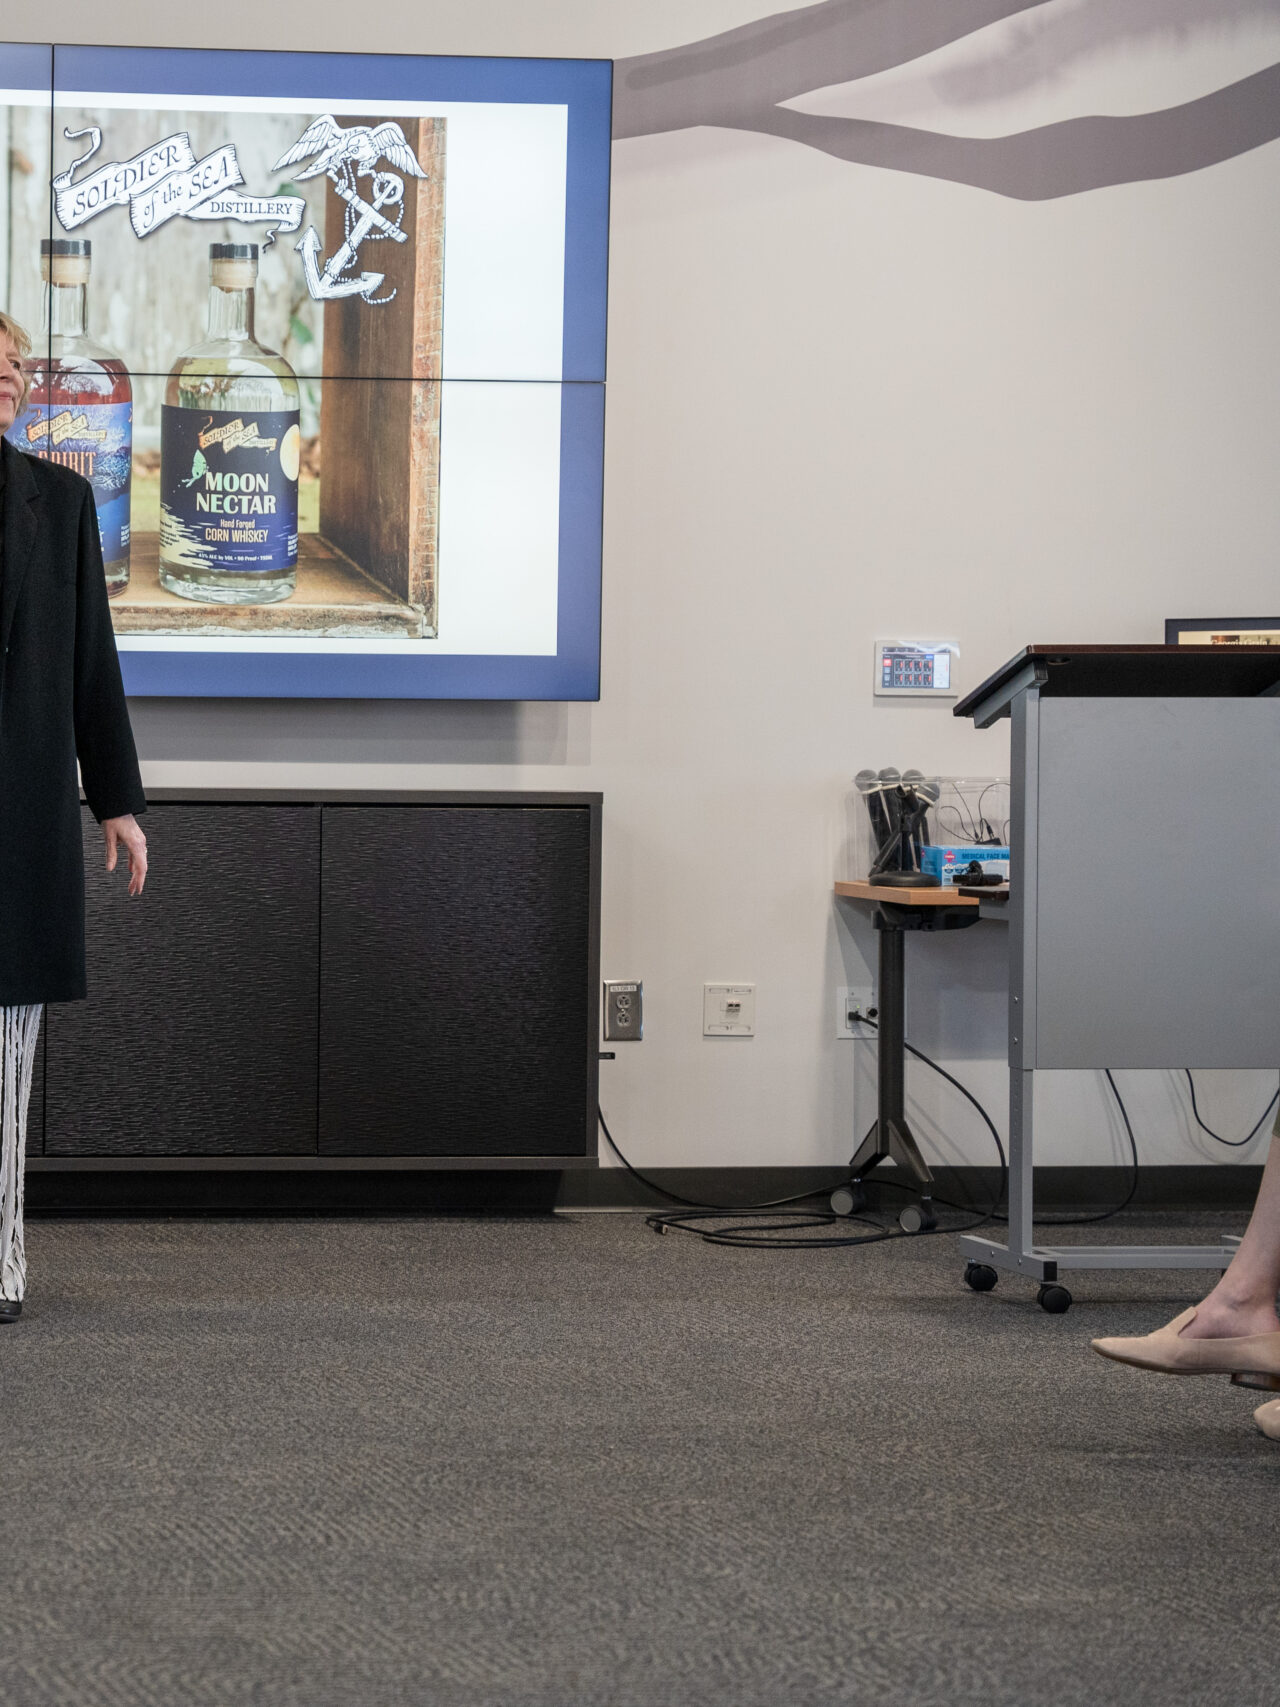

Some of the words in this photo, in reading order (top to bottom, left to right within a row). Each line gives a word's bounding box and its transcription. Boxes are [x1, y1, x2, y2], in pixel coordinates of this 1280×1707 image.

[72, 144, 181, 218] SOLDIER
[143, 190, 159, 229] of
[162, 183, 183, 204] the
[188, 155, 229, 199] SEA
[210, 201, 293, 215] DISTILLERY
[205, 471, 269, 493] MOON
[196, 492, 276, 514] NECTAR
[205, 527, 230, 542] CORN
[231, 529, 269, 543] WHISKEY
[220, 518, 235, 528] Hand
[235, 519, 256, 530] Forged
